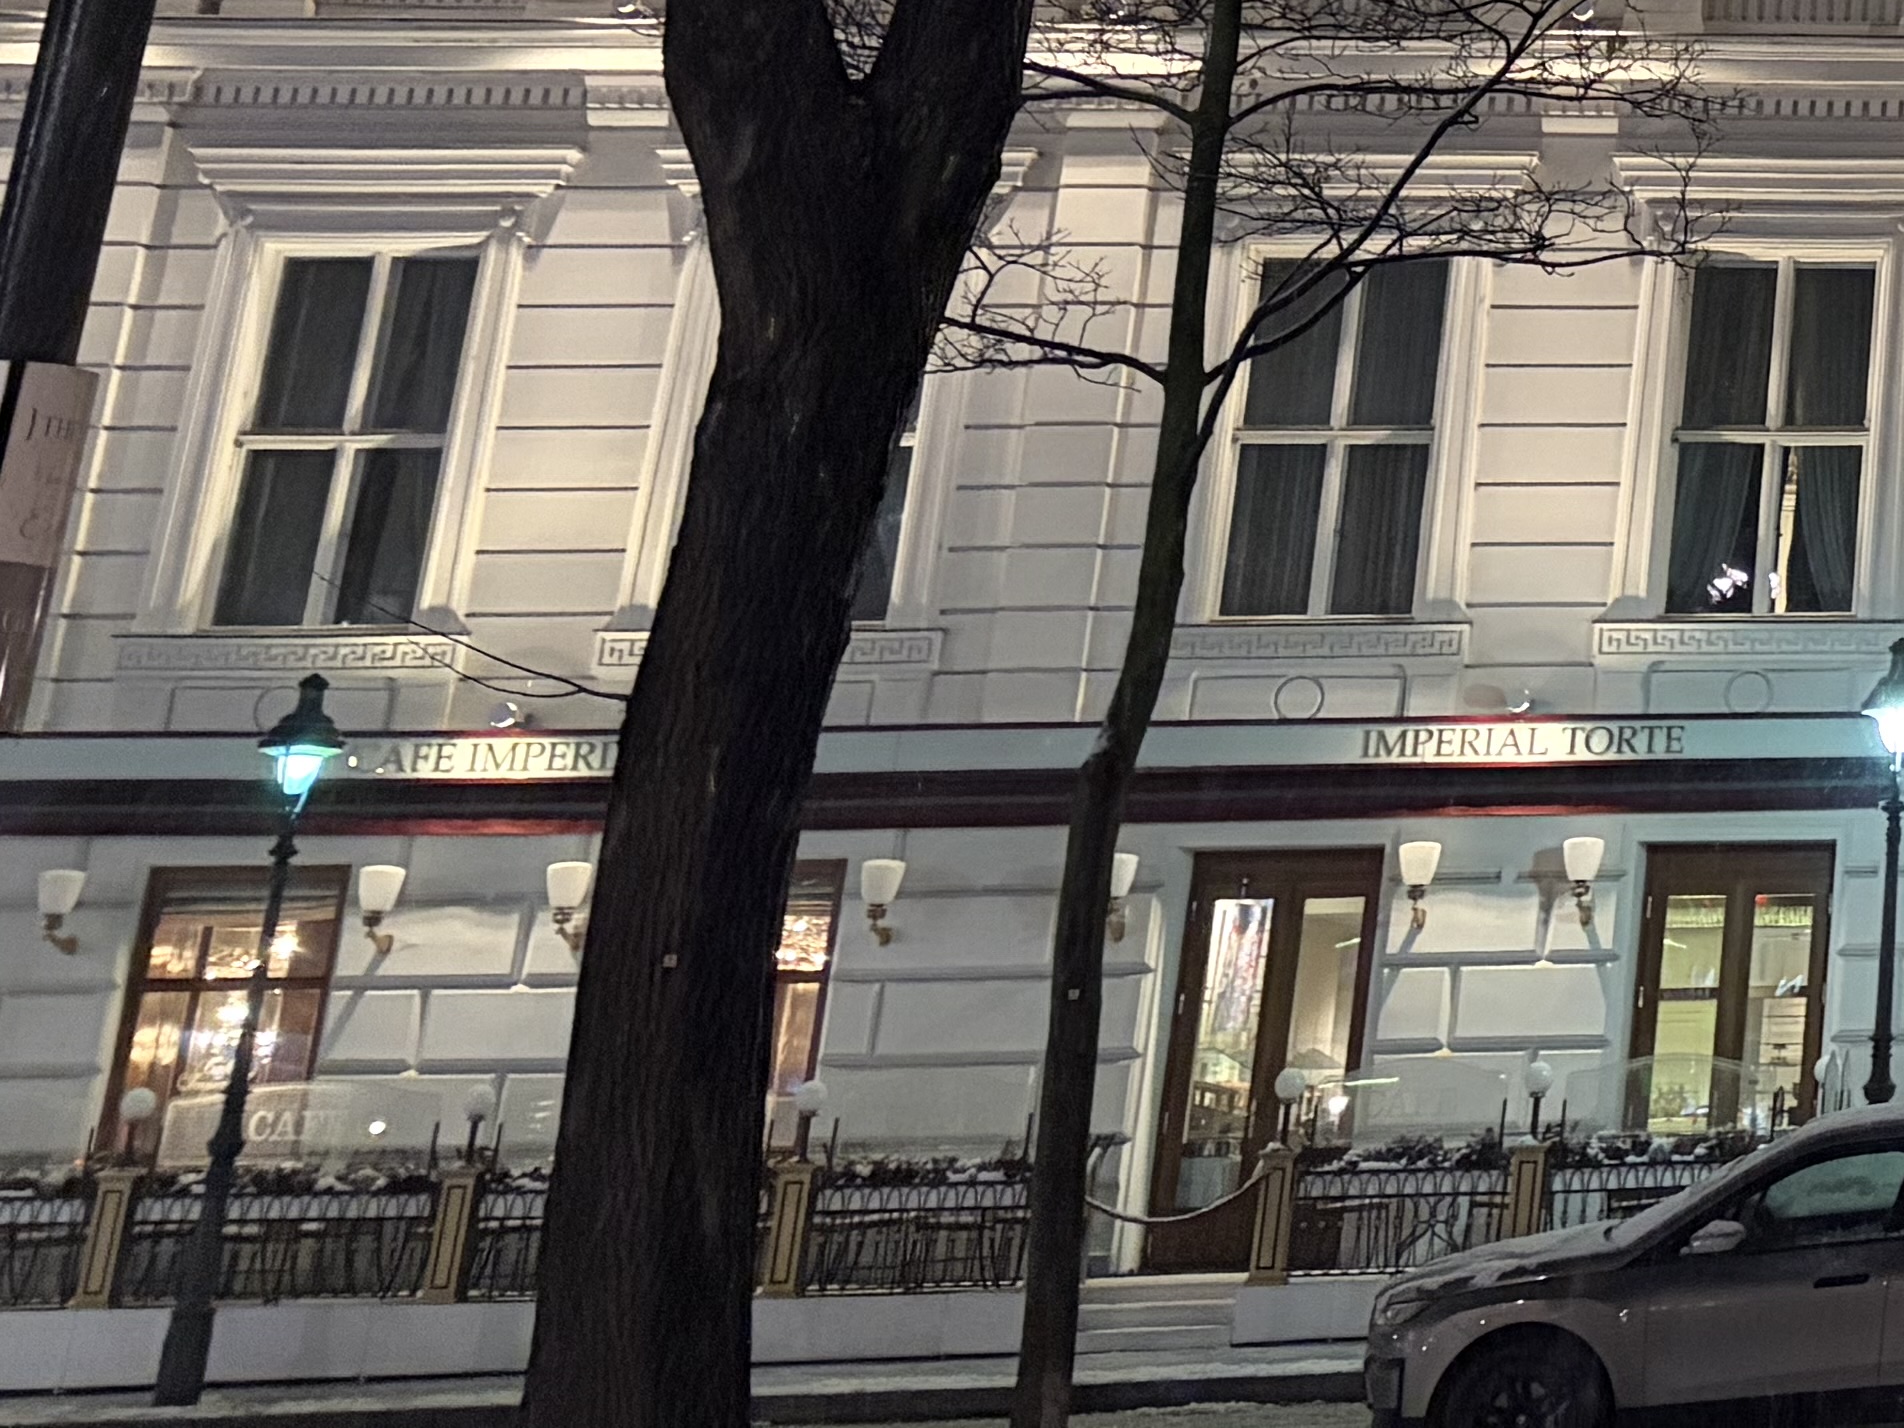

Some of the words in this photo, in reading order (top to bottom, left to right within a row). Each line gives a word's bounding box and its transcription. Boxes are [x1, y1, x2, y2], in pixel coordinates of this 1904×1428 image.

[465, 740, 616, 774] IMPERI
[1359, 726, 1549, 759] IMPERIAL
[1561, 724, 1687, 756] TORTE
